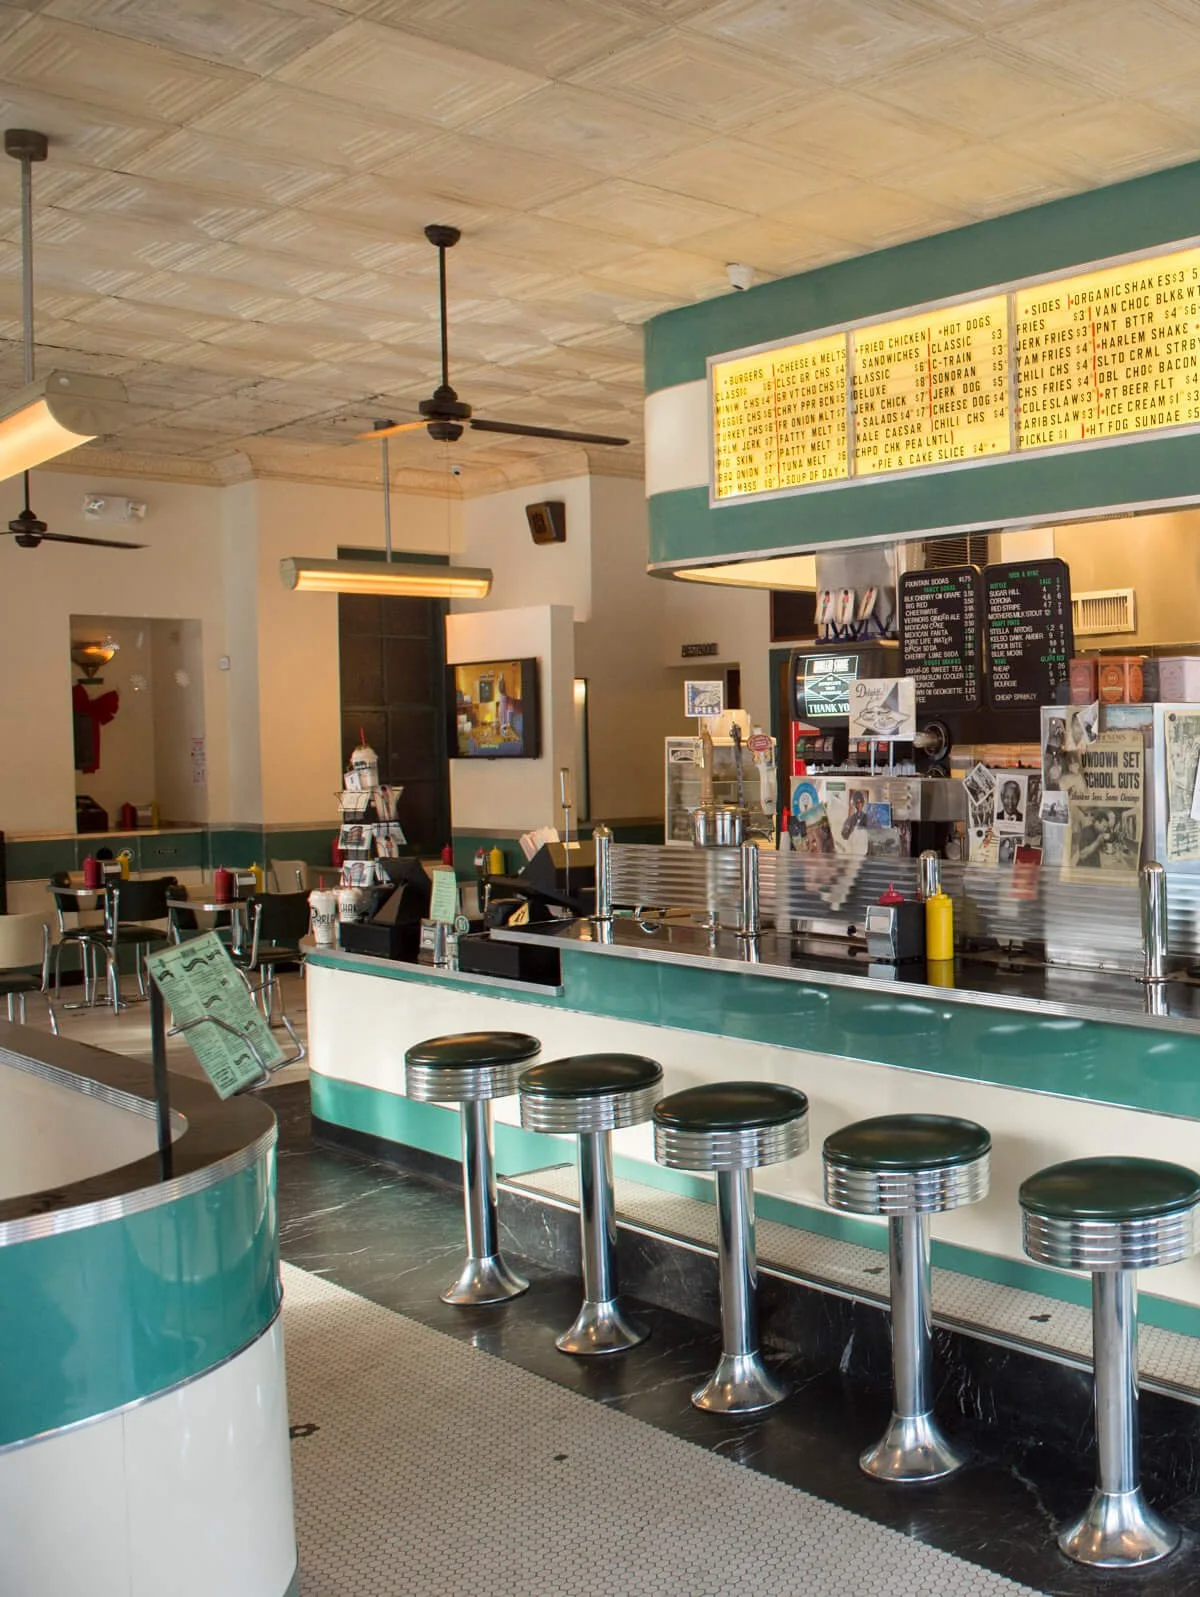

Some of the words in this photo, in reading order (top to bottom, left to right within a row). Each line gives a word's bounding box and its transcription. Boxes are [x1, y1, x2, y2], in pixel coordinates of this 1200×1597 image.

[1074, 284, 1121, 306] ORGANIC
[1125, 274, 1171, 294] SHAKES
[1032, 299, 1061, 315] SIDES
[1096, 303, 1117, 317] VAN
[1122, 295, 1149, 312] CHOC
[1187, 285, 1200, 298] WT
[943, 323, 960, 336] HOT
[967, 315, 991, 329] DOGS
[1017, 319, 1045, 335] FRIES
[1096, 320, 1116, 333] PNT
[1126, 312, 1153, 328] BTTR
[860, 341, 884, 354] FRIED
[889, 331, 926, 348] CHICKEN
[932, 336, 972, 353] CLASSIC
[1017, 335, 1040, 350] JERK
[1045, 329, 1073, 345] FRIES
[1102, 331, 1145, 349] HARLEM
[1152, 323, 1188, 340] SHAKE
[780, 357, 808, 373] CHEESE
[812, 356, 816, 366] &
[821, 349, 846, 363] MELTS
[862, 348, 919, 368] SANDWICHES
[932, 351, 972, 369] C-TRAIN
[1016, 354, 1038, 368] YAM
[1042, 346, 1071, 362] FRIES
[1130, 345, 1159, 361] CRML
[730, 369, 763, 385] BURGERS
[777, 375, 796, 388] CLSC
[815, 368, 830, 379] CHS
[853, 369, 890, 386] CLASSIC
[933, 366, 976, 385] SONORAN
[1018, 368, 1044, 383] CHILI
[1050, 363, 1069, 377] CHS
[1099, 369, 1118, 383] DBL
[1126, 364, 1152, 379] CHOC
[1159, 355, 1197, 372] BACON
[819, 381, 834, 392] CHS
[854, 385, 886, 400] DELUXE
[933, 386, 954, 399] JERK
[963, 381, 980, 394] DOG
[1018, 385, 1037, 399] CHS
[1043, 378, 1072, 394] FRIES
[1105, 386, 1117, 399] RT
[1122, 381, 1149, 396] BEER
[1154, 377, 1173, 391] FLT
[777, 403, 797, 416] CHRY
[819, 395, 834, 407] BCN
[855, 401, 874, 415] JERK
[881, 396, 906, 410] CHICK
[933, 400, 968, 415] CHEESE
[973, 395, 990, 407] DOG
[1106, 403, 1123, 416] ICE
[1127, 395, 1166, 412] CREAM
[747, 410, 761, 420] CHS
[779, 420, 788, 430] FR
[792, 414, 815, 427] ONION
[819, 410, 834, 422] MLT
[863, 411, 897, 427] SALADS
[935, 417, 959, 430] CHILI
[968, 412, 985, 424] CHS
[1090, 422, 1103, 435] HT
[1135, 409, 1180, 428] SUNDAE
[749, 424, 763, 435] CHS
[780, 432, 805, 443] FATTY
[812, 425, 832, 437] MELT
[856, 426, 879, 442] KALE
[886, 423, 922, 438] CAESAR
[1019, 430, 1053, 446] PICKLE
[742, 439, 761, 451] JERK
[780, 445, 805, 457] PATTY
[811, 440, 830, 451] MELT
[885, 441, 900, 453] CHK
[906, 436, 922, 448] PEA
[926, 431, 948, 447] LNTL
[737, 454, 753, 465] SKIN
[782, 458, 803, 471] TUNA
[807, 455, 826, 467] MELT
[878, 457, 891, 469] PIE
[898, 455, 902, 465] &
[910, 451, 932, 465] CAKE
[939, 446, 964, 459] SLICE
[737, 467, 759, 479] ONION
[786, 472, 805, 484] SOUP
[810, 470, 817, 480] OF
[822, 467, 839, 478] DAY
[808, 704, 837, 713] THANK
[838, 703, 849, 712] YO
[1123, 752, 1140, 768] SET
[1084, 772, 1115, 788] SCHOOL
[1119, 772, 1139, 789] CUTS
